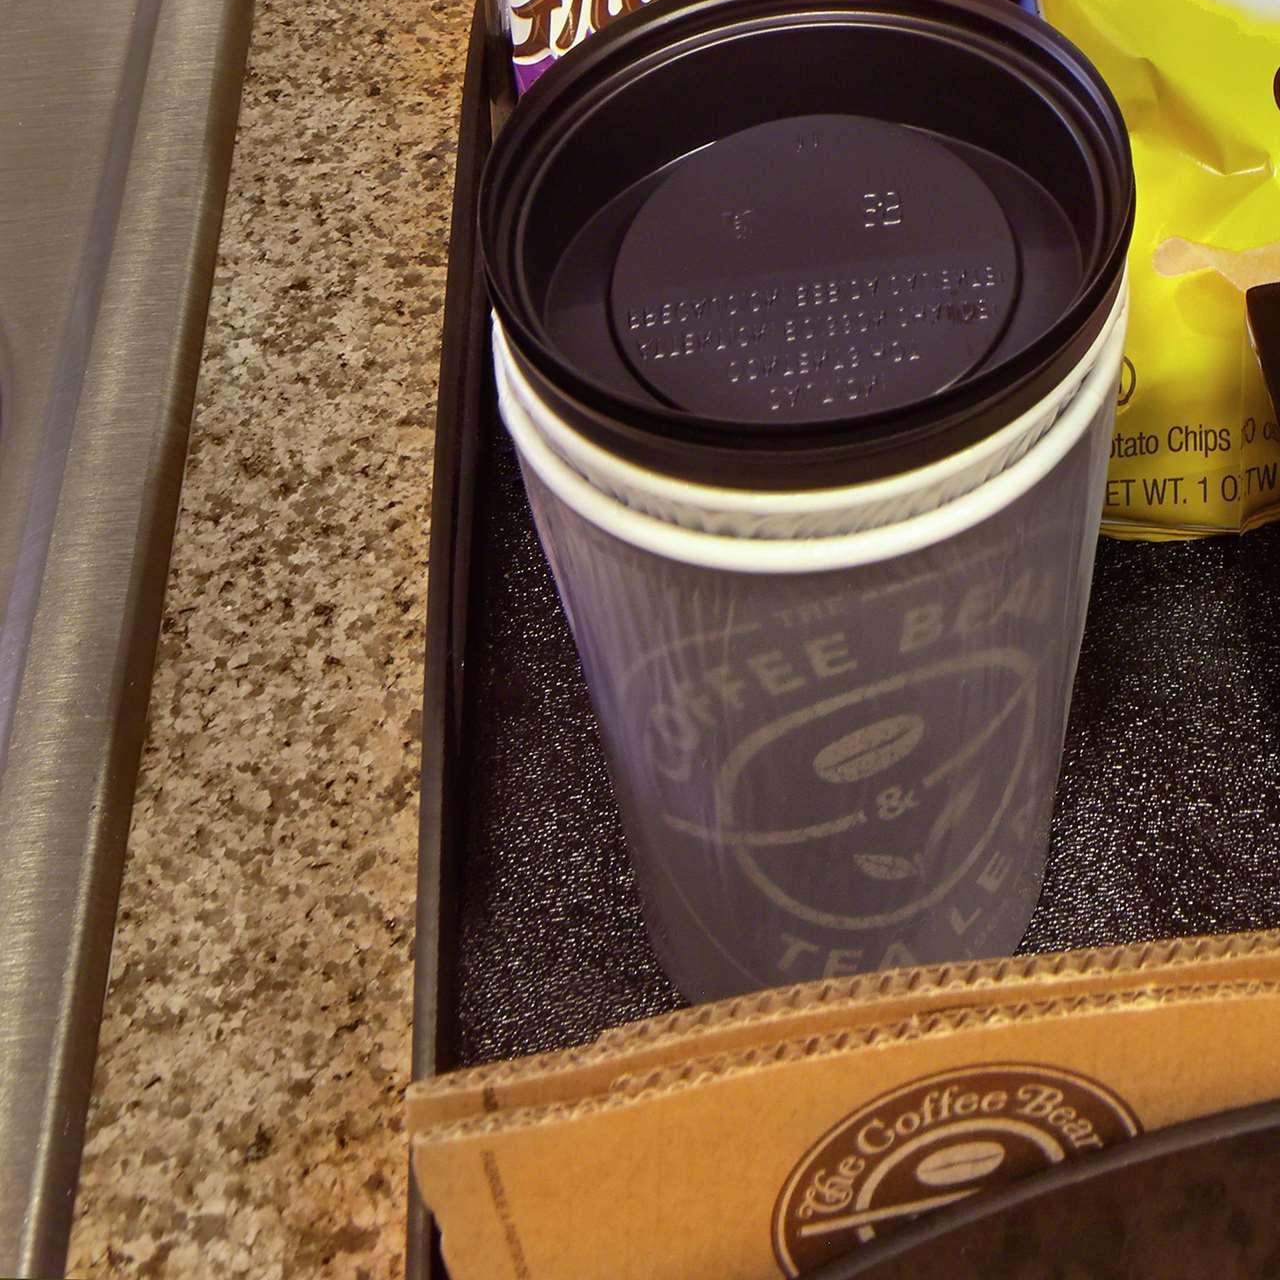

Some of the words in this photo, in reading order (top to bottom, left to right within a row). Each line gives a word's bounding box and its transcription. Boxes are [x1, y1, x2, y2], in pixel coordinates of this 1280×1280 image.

[1167, 424, 1231, 458] Chips
[1142, 477, 1187, 506] WT.
[647, 631, 860, 782] COFFEE
[795, 1154, 867, 1220] The
[857, 1084, 1009, 1155] Coffee
